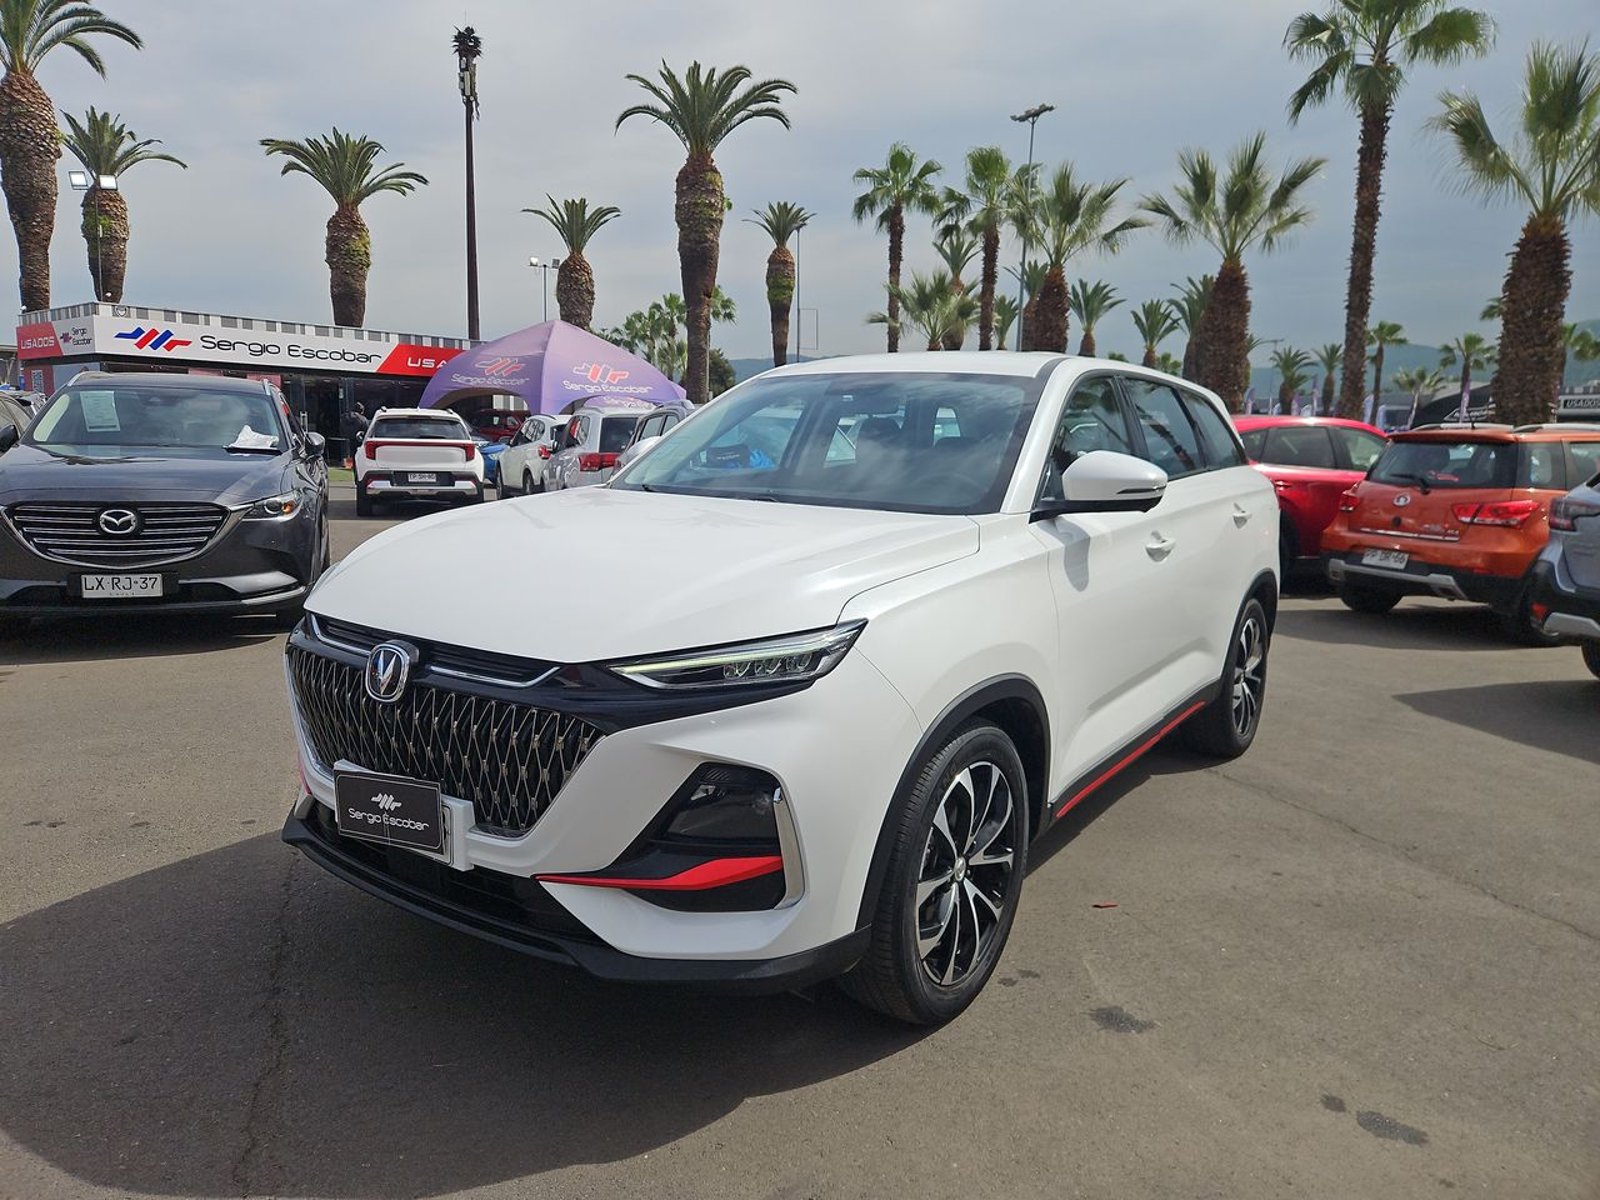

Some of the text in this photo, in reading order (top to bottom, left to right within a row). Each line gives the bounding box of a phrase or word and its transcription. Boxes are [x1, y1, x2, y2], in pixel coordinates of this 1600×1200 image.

[20, 336, 55, 350] USADOS
[200, 335, 382, 363] Sergio Escobar
[348, 807, 430, 831] Sergio Escobar
